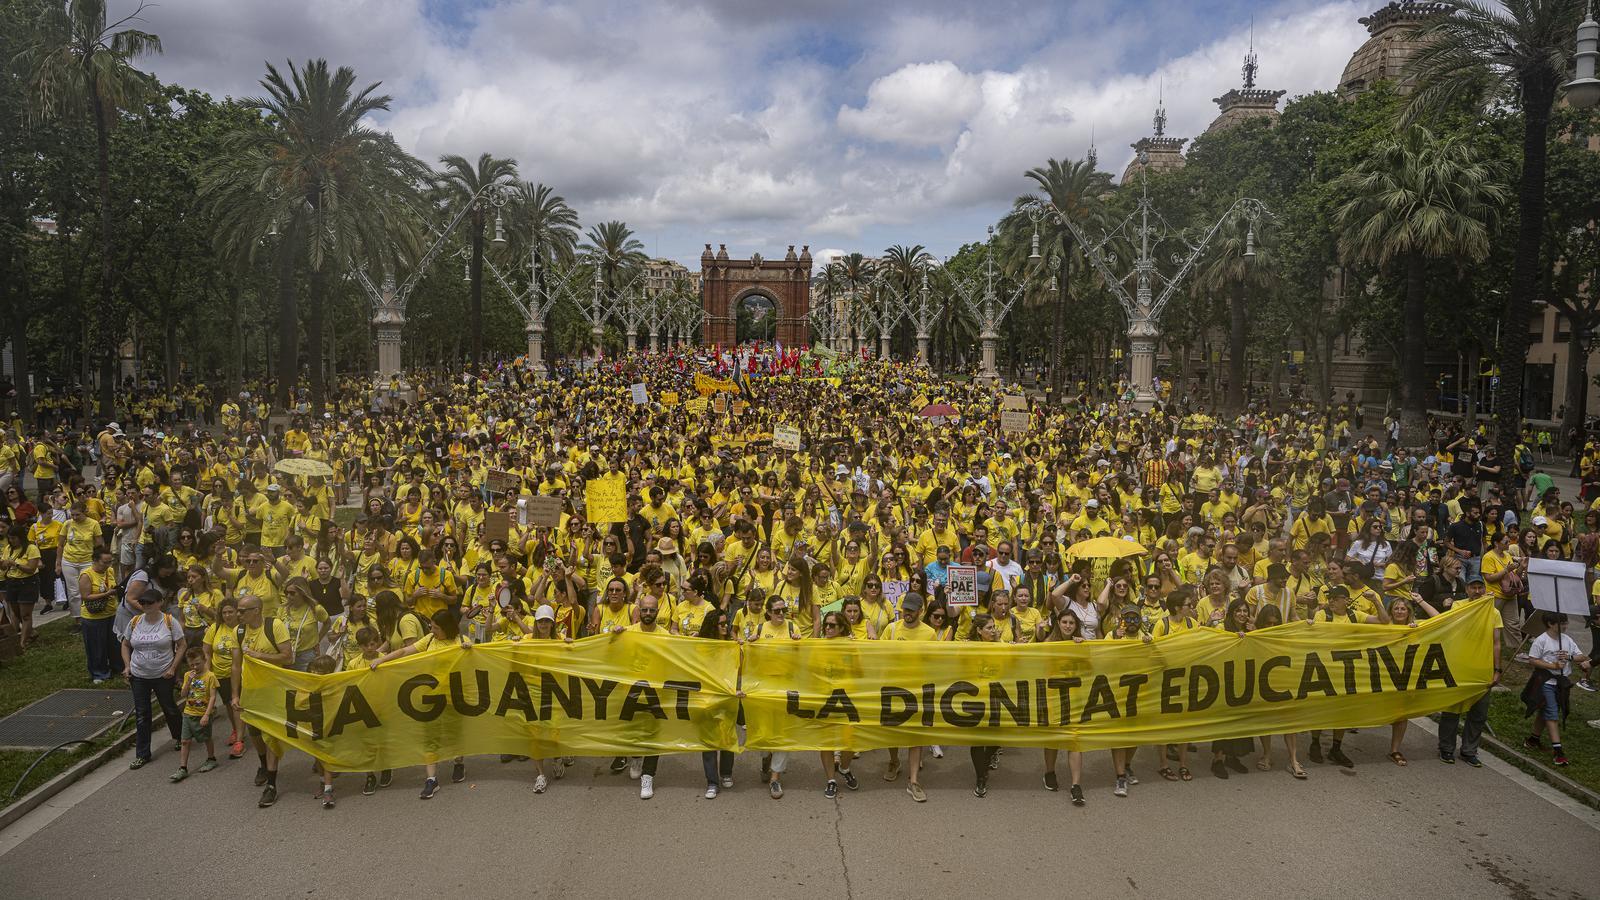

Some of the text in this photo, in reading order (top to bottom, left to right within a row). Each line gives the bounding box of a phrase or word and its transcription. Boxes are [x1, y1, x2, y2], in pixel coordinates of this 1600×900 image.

[1492, 378, 1498, 386] P
[883, 583, 896, 594] LS
[951, 581, 973, 592] PAE
[285, 643, 1459, 741] HA GUANYAT LA DIGNITAT EDUCATIVA
